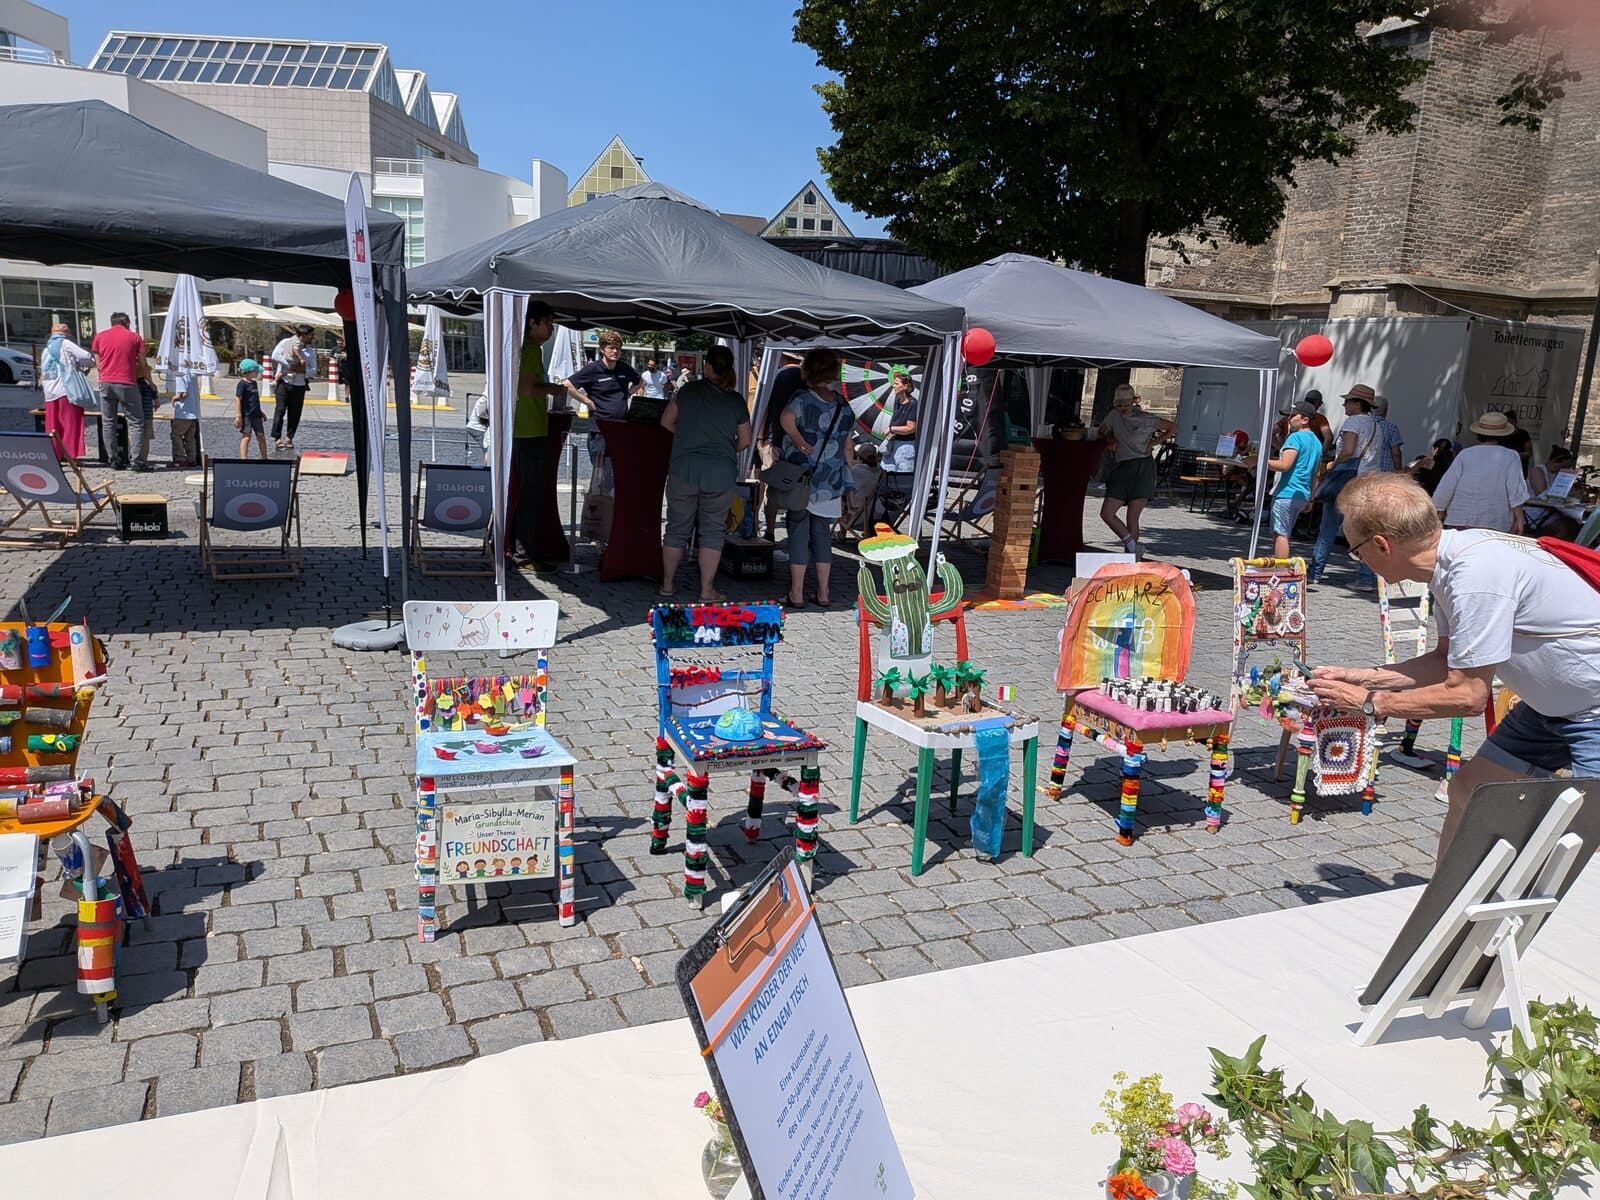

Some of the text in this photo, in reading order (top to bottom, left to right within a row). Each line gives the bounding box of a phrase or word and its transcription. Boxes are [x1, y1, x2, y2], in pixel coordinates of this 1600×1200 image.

[1494, 330, 1565, 352] Toilettenwagen
[1086, 581, 1168, 606] SCHWARZ
[694, 625, 720, 643] AN
[454, 807, 545, 826] Maria-Sibylla-Merian
[475, 818, 521, 829] Grundschule
[476, 830, 494, 838] Unser
[446, 836, 550, 858] FREUNDSCHAFT
[731, 1018, 750, 1050] WIR
[748, 976, 779, 1026] KINDER
[778, 959, 792, 983] DER
[790, 935, 808, 963] WELT
[753, 975, 809, 1064] AN EINEM TISCH
[780, 1070, 791, 1092] Eine
[776, 1107, 788, 1128] zum
[787, 1120, 797, 1139] des
[796, 1095, 811, 1124] Ulmer
[777, 1165, 792, 1196] Kinder
